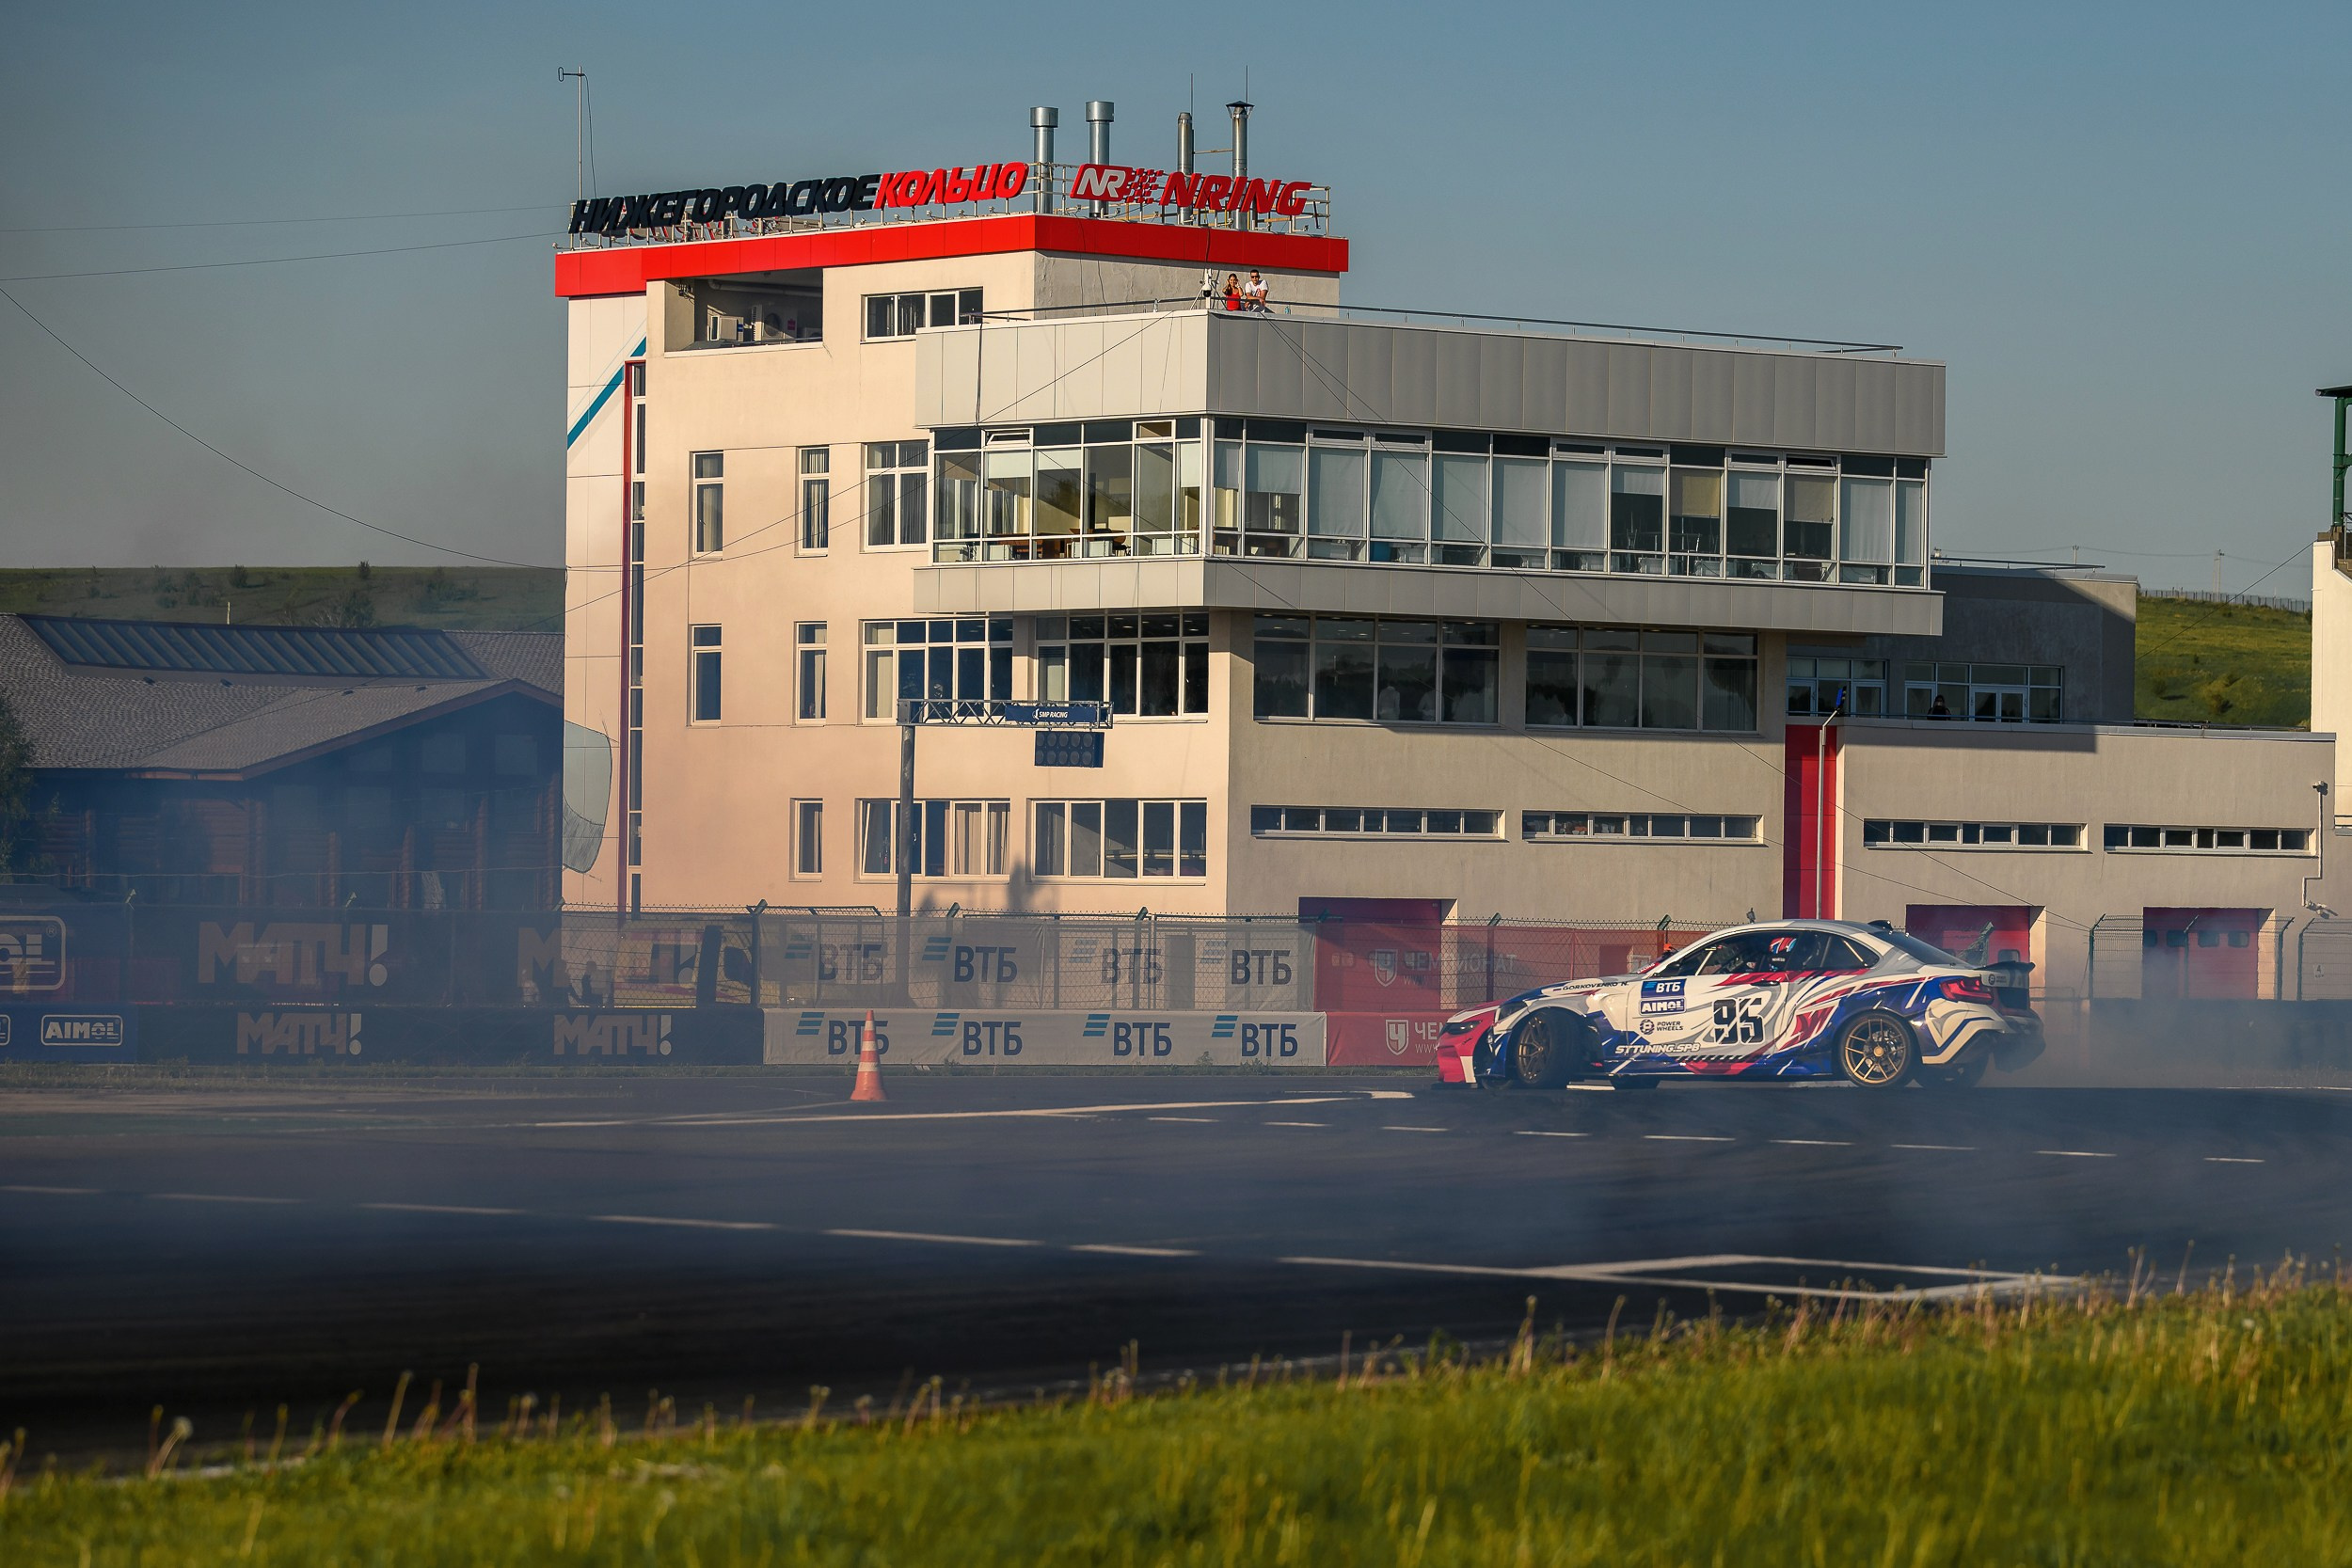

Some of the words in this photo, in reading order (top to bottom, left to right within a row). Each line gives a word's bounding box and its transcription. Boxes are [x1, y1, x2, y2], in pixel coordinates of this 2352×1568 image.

[568, 173, 882, 234] НИЖЕГОРОДСКОЕ
[872, 162, 1030, 209] КОЛЬЦО
[1079, 166, 1126, 198] NR
[1158, 170, 1311, 216] NRING
[818, 943, 884, 982] ВТБ
[953, 945, 1018, 983] ВТБ
[1101, 947, 1164, 984] ВТБ
[1231, 948, 1293, 986] ВТБ
[1562, 981, 1618, 990] GORKOVENKO
[1655, 981, 1681, 993] ВТБ
[1642, 1001, 1684, 1013] AIMOL
[1712, 997, 1765, 1045] 95
[45, 1022, 119, 1039] AIMOL
[236, 1012, 362, 1055] МАТЧ!
[553, 1014, 672, 1056] МАТЧ!
[828, 1020, 890, 1055] ВТБ
[962, 1021, 1024, 1056] ВТБ
[1113, 1022, 1172, 1057] ВТБ
[1241, 1023, 1298, 1057] ВТБ
